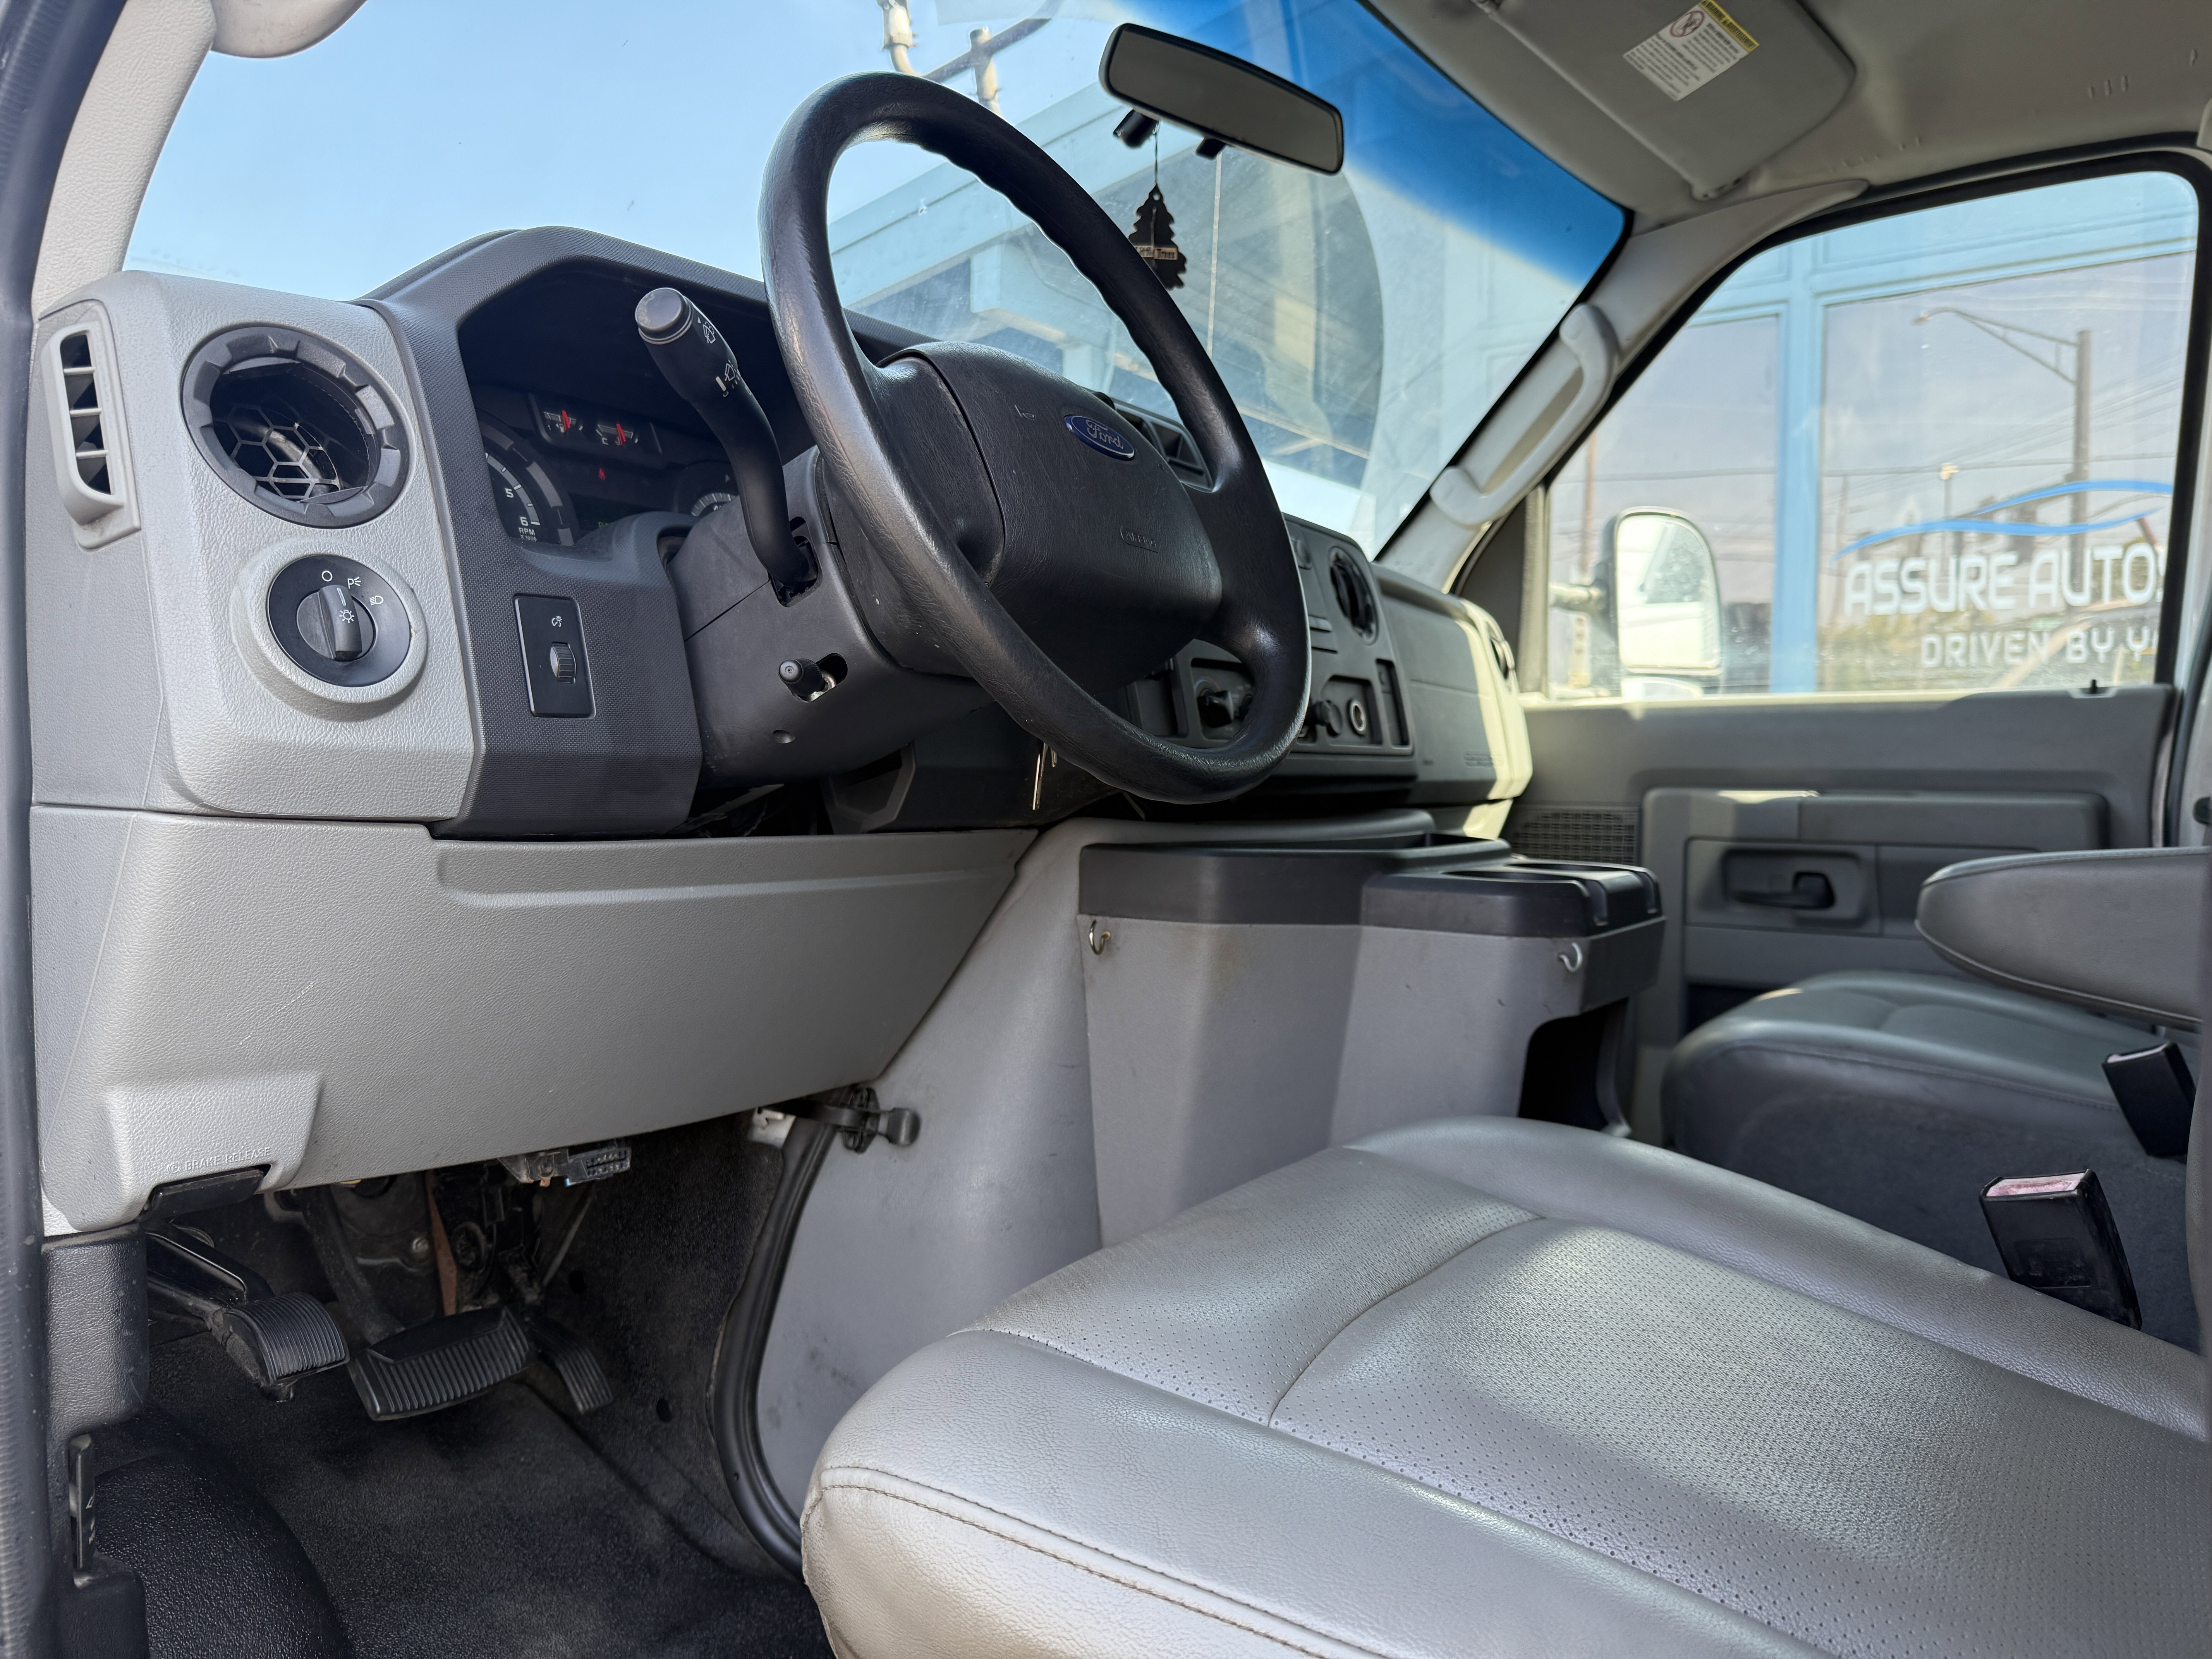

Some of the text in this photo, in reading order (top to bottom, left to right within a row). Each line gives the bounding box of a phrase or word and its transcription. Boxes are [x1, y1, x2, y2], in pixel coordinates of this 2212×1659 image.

[1085, 419, 1124, 449] Ford
[505, 488, 514, 498] 5
[519, 527, 536, 536] RPM
[520, 517, 529, 526] 6
[1844, 551, 2018, 616] ASSURE
[1921, 630, 2050, 668] DRIVEN
[2066, 627, 2115, 664] BY
[185, 1156, 221, 1171] BRAKE
[225, 1147, 271, 1163] RELEASE
